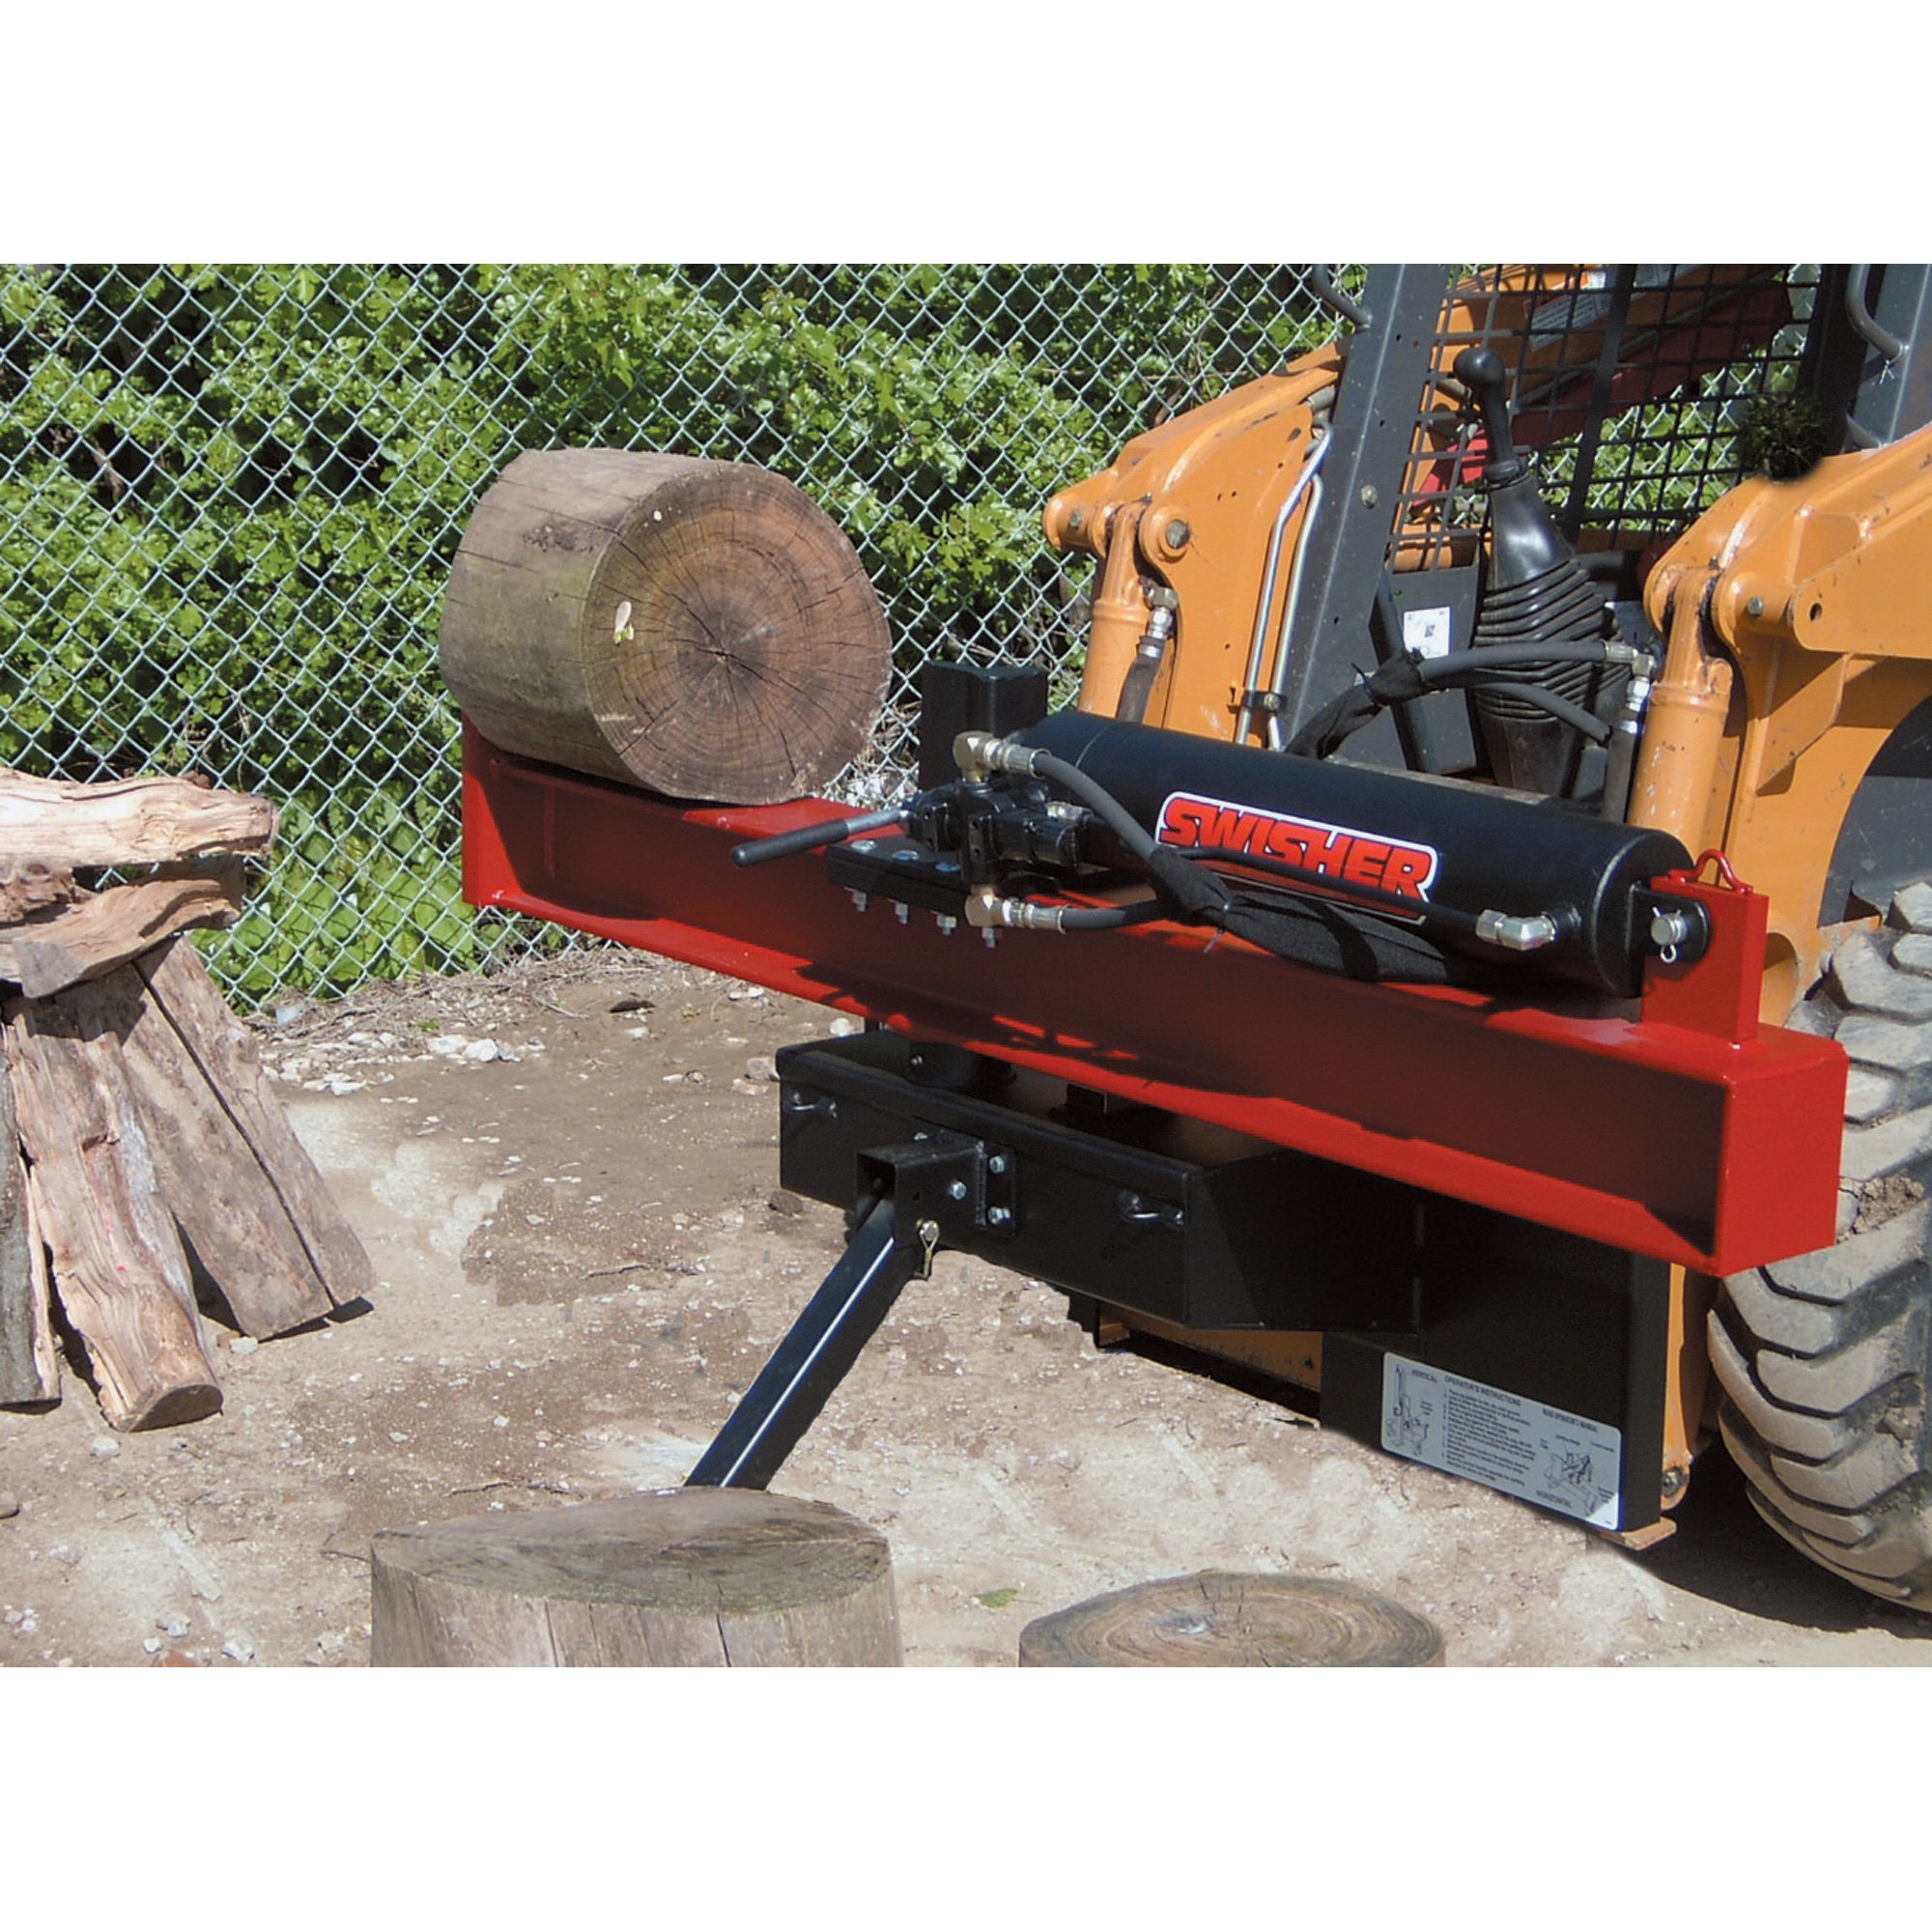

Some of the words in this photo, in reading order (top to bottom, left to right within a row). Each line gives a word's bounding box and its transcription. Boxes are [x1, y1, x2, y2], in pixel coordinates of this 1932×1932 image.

[1159, 797, 1433, 901] SWISHER
[1411, 1369, 1437, 1384] VERTICAL
[1480, 1386, 1521, 1406] INSTRUCTIONS
